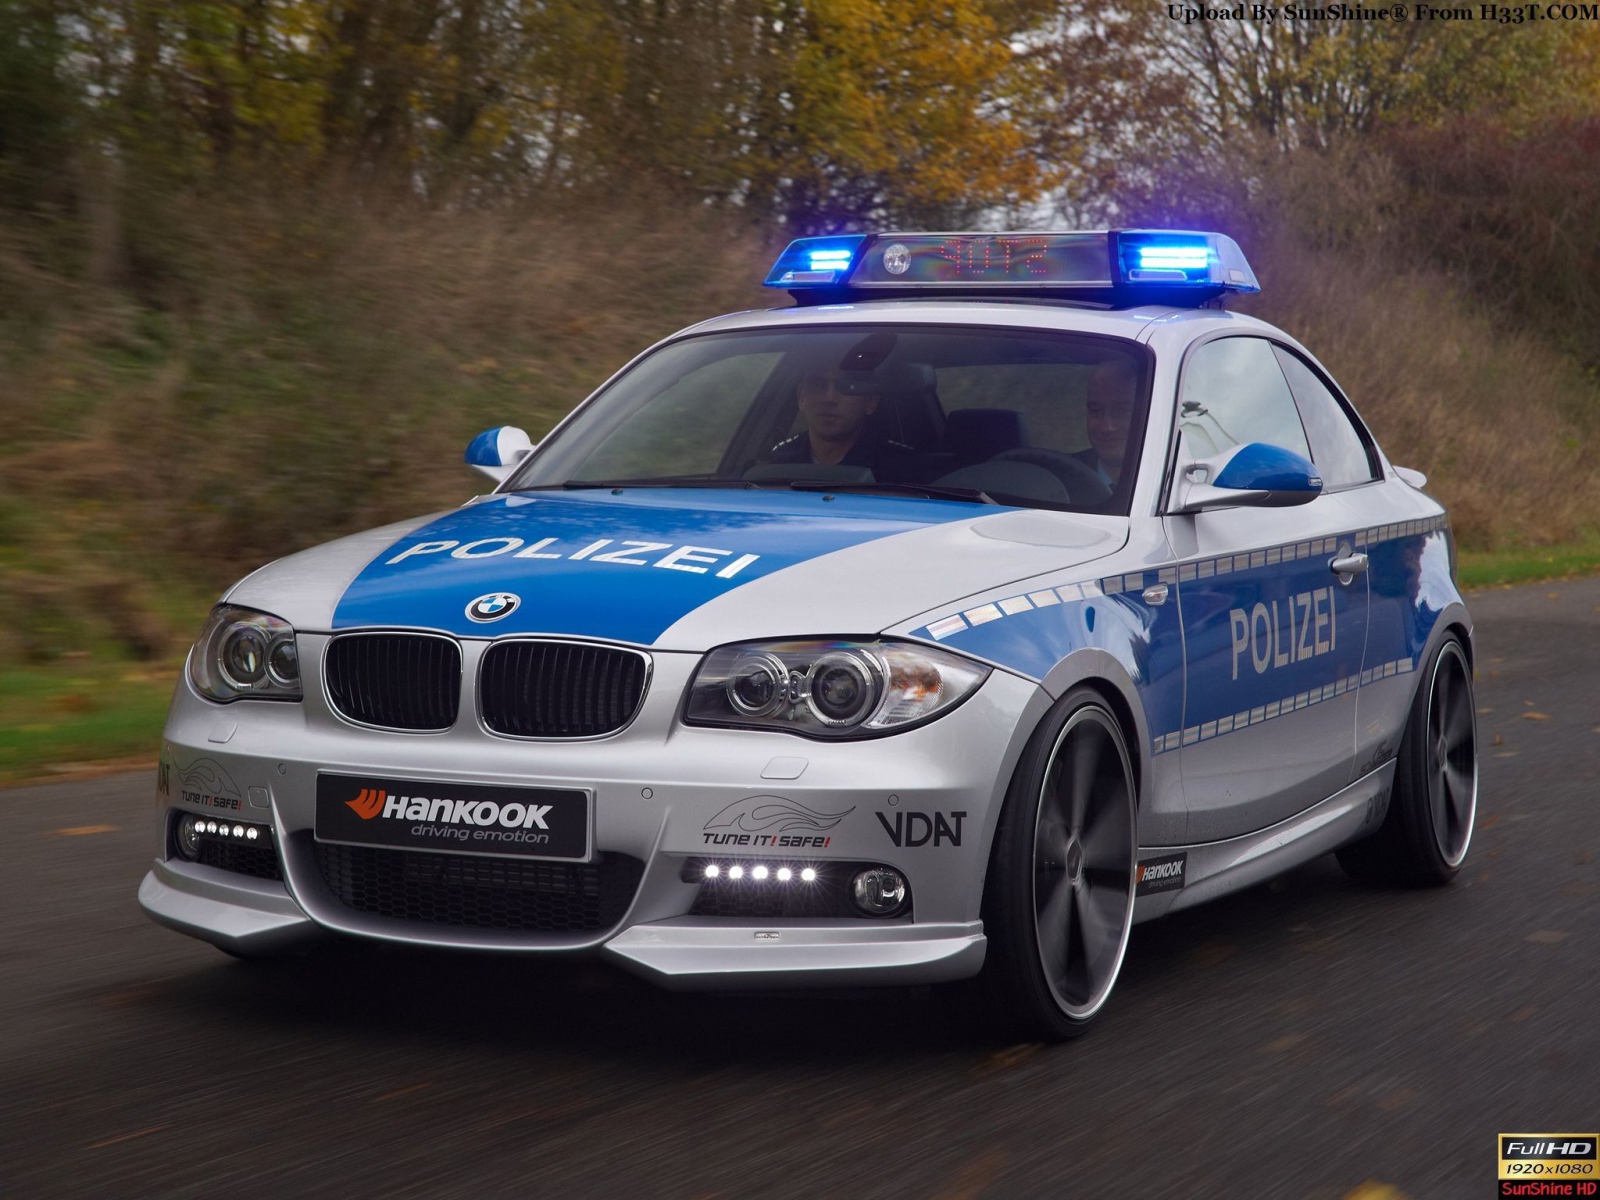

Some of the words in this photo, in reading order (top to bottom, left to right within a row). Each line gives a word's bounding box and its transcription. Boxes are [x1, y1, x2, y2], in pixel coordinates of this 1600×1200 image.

[385, 537, 760, 579] POLIZEI
[1229, 585, 1337, 681] POLIZEI
[411, 823, 468, 841] driving
[472, 829, 549, 844] emotion
